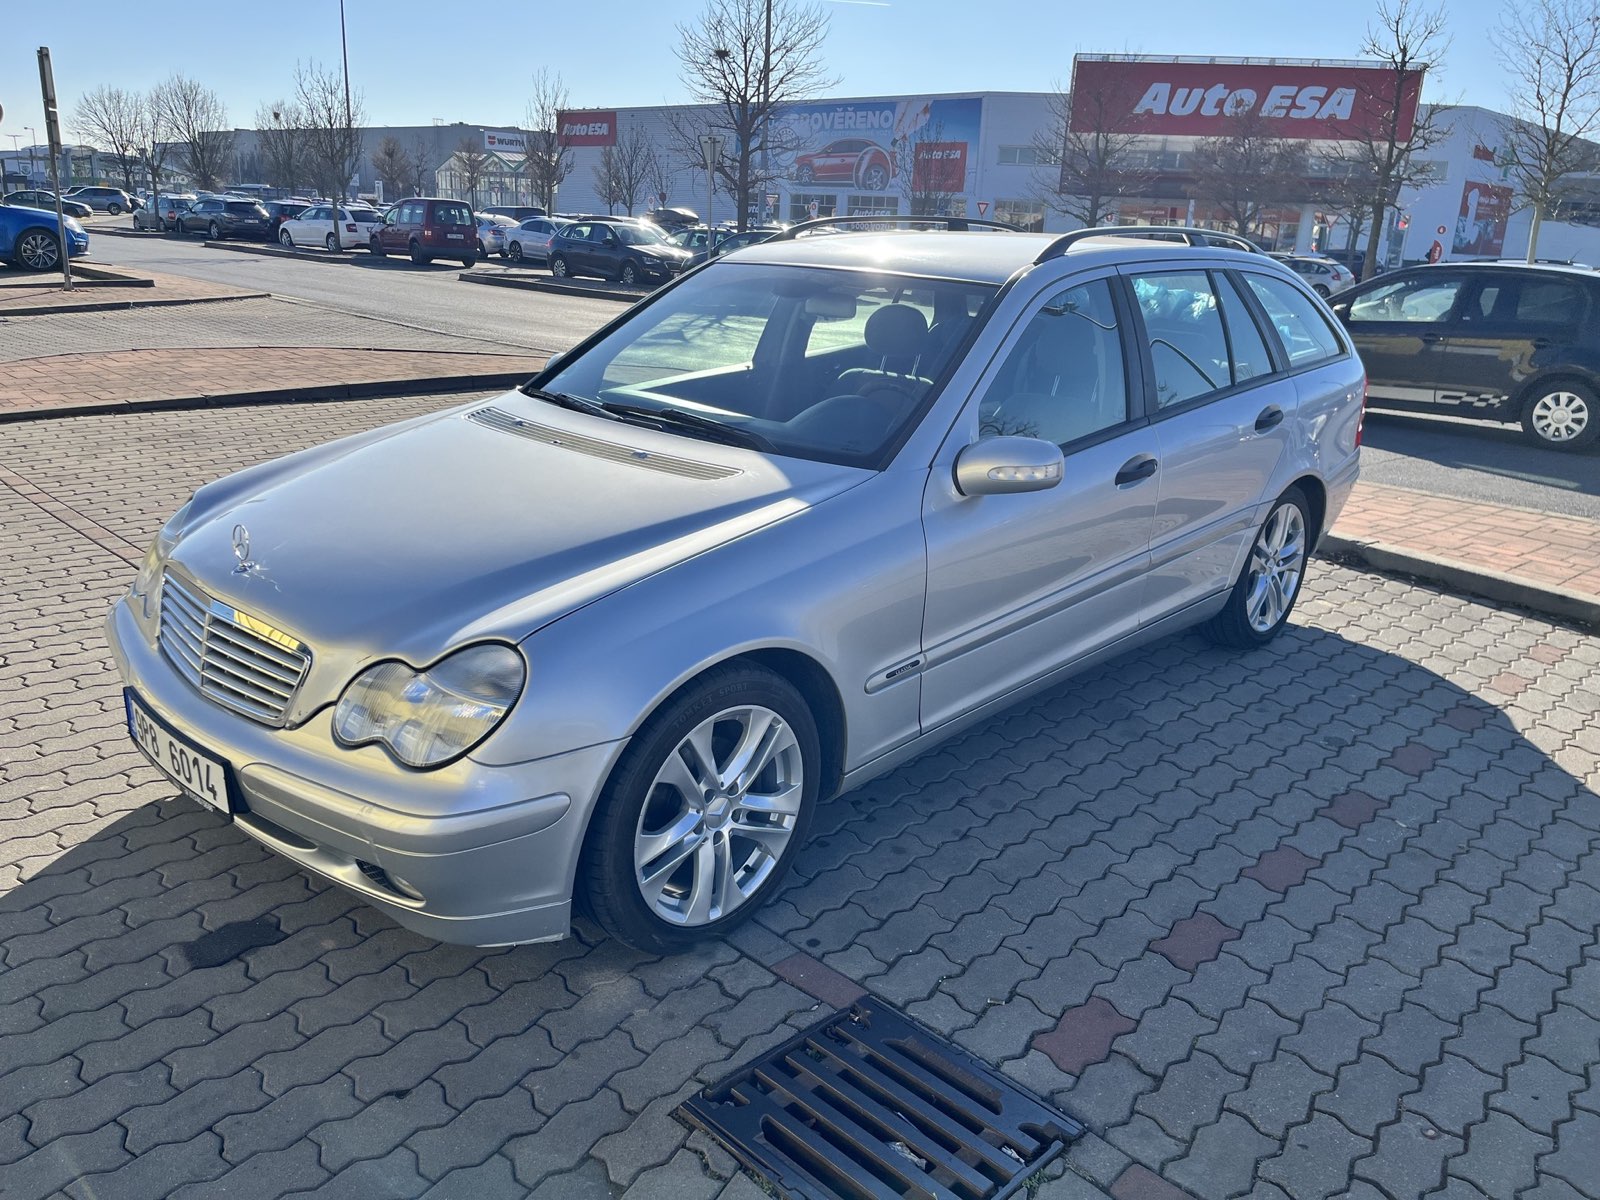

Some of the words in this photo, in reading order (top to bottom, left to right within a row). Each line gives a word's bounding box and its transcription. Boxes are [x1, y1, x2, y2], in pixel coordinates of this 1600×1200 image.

[1133, 82, 1257, 117] Auto
[1258, 85, 1357, 121] ESA
[562, 123, 588, 136] Auto
[587, 122, 609, 136] ESA
[719, 682, 749, 697] SPORT
[168, 740, 218, 801] 6014
